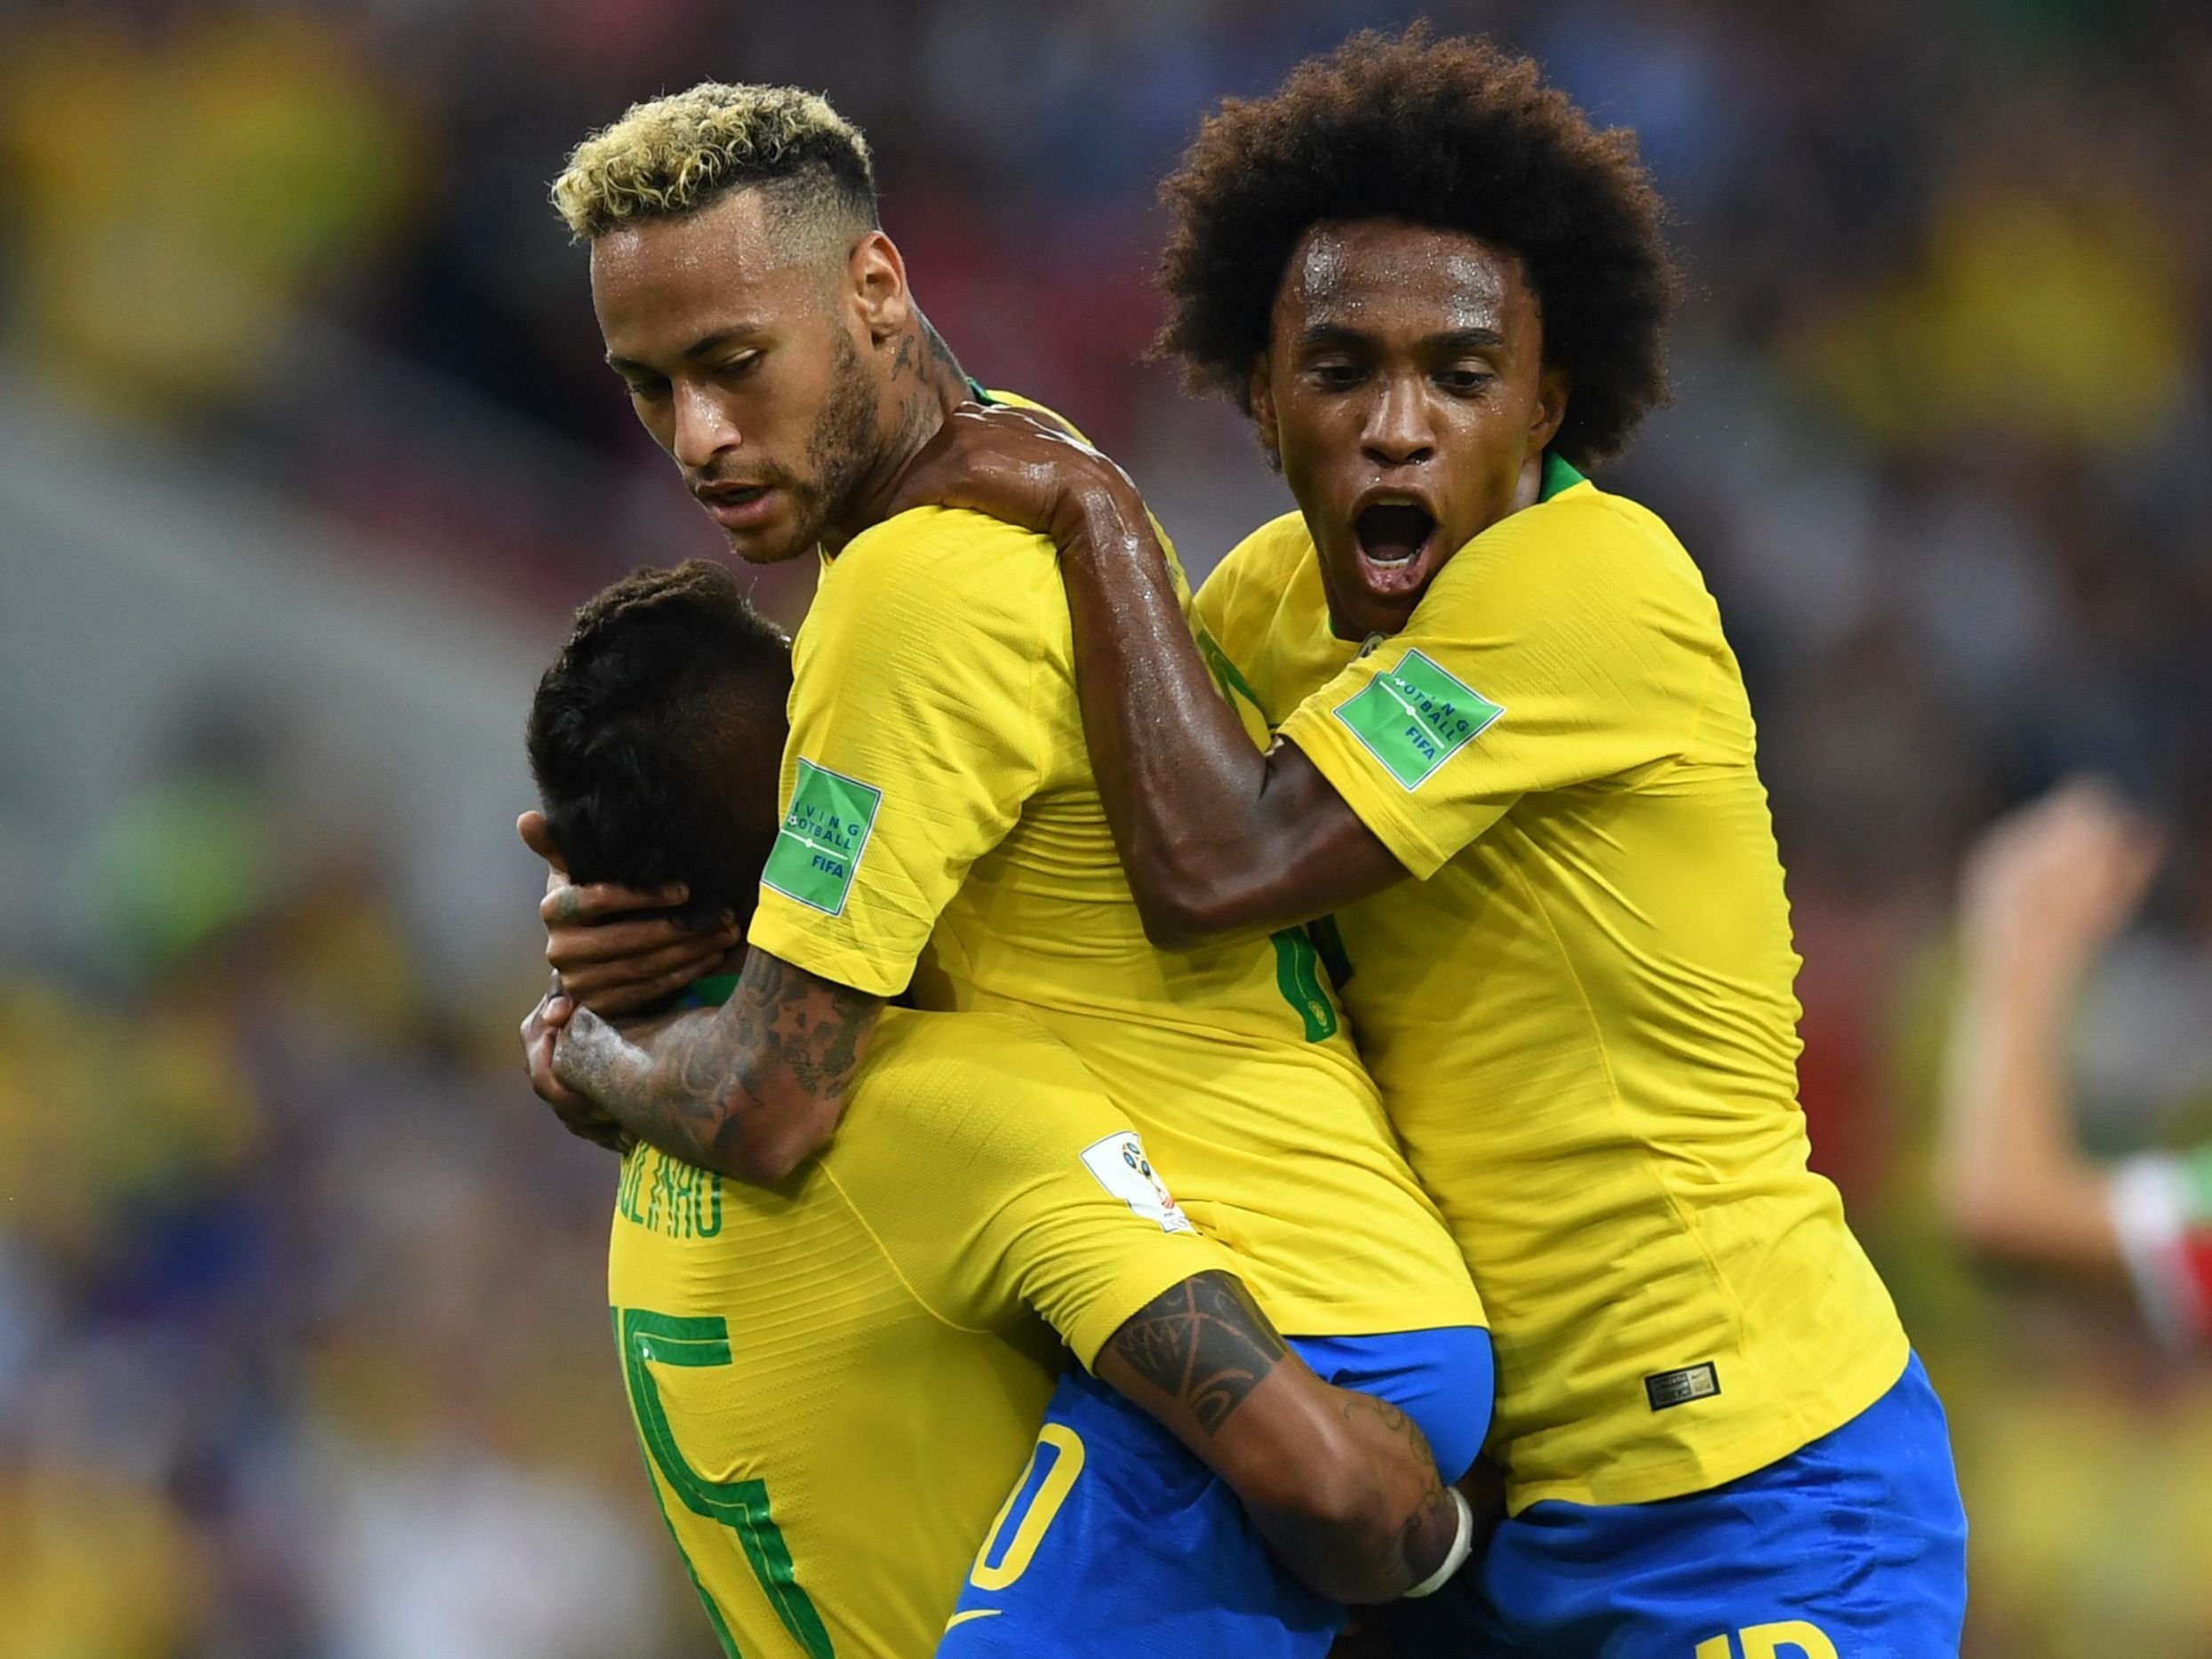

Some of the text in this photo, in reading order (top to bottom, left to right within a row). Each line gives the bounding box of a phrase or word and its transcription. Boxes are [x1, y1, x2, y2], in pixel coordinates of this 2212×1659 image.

[1395, 678, 1456, 741] OTBALL
[1405, 725, 1435, 761] FIFA
[788, 817, 851, 850] OTBALL
[794, 802, 859, 836] IVING
[811, 854, 843, 879] FIFA
[610, 1305, 835, 1659] 5
